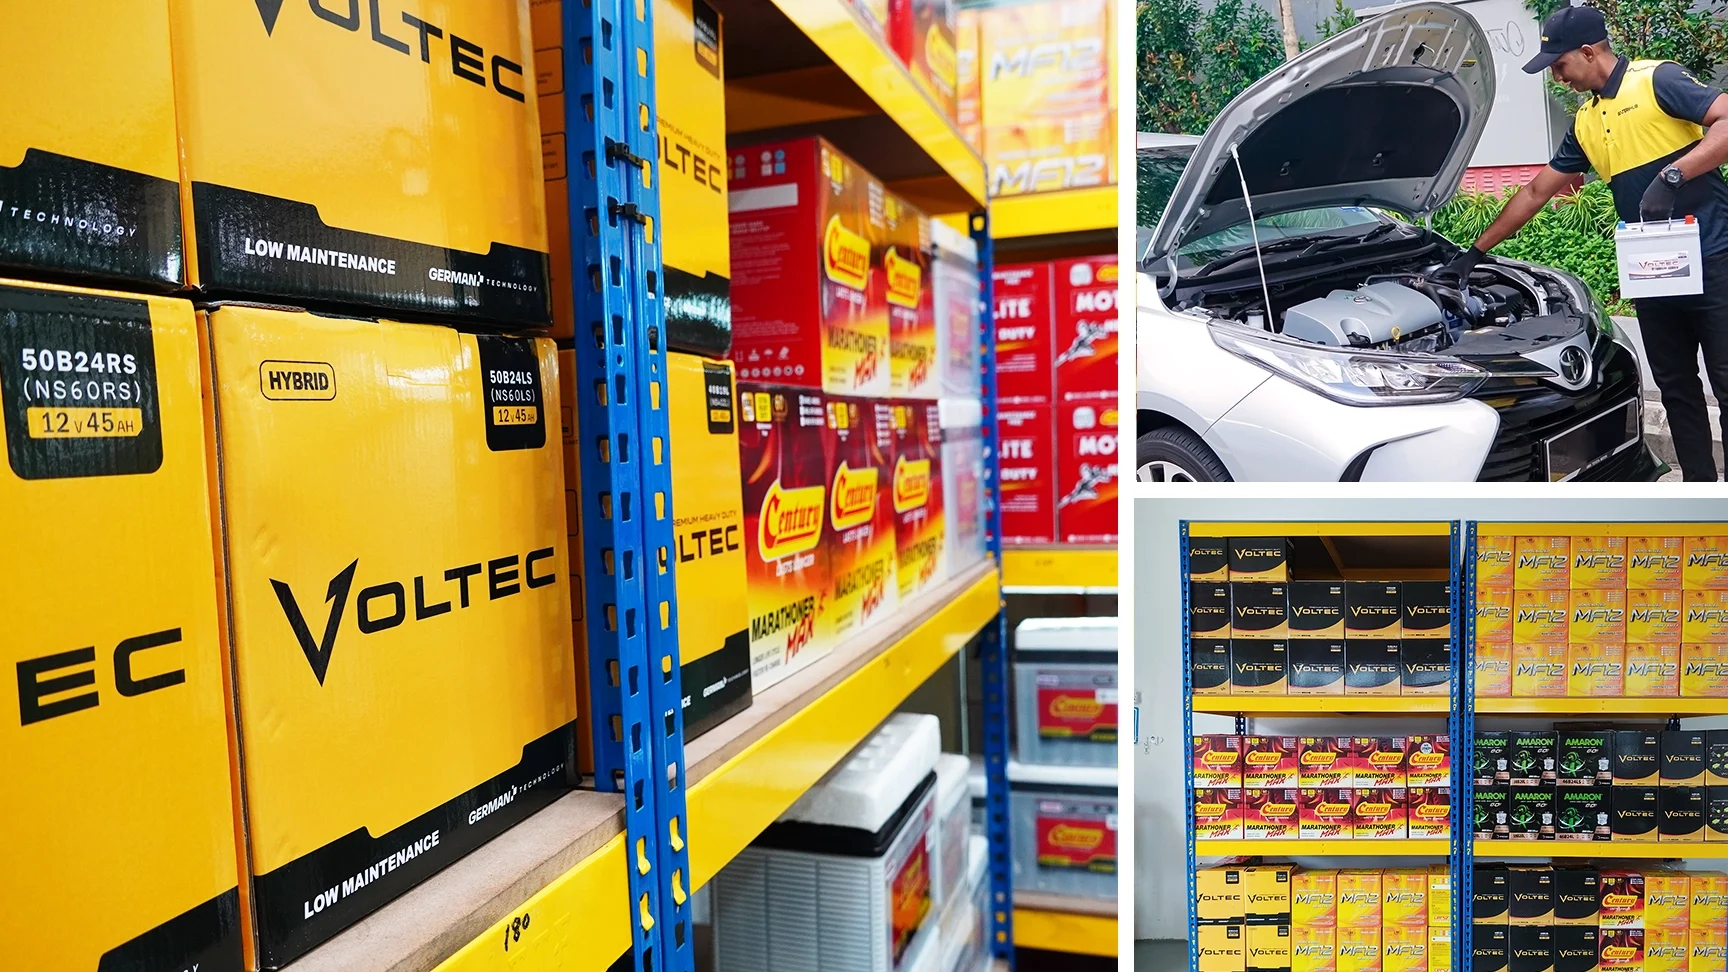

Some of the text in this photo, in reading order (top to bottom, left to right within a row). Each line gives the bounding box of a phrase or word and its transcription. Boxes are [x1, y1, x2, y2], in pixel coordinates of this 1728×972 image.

[255, 0, 525, 103] OLTEC
[657, 133, 721, 195] LTEC
[991, 154, 1105, 195] MF12
[10, 206, 136, 238] TECHNOLOGY
[245, 238, 396, 275] LOW MAINTENANCE
[428, 267, 538, 293] GERMAN TECHNOLOGY
[22, 348, 137, 375] 50B24RS
[268, 370, 330, 393] HYBRID
[489, 369, 533, 385] 50B24LS
[23, 377, 141, 403] (NS60RS)
[490, 387, 536, 403] (NS60LS)
[42, 411, 70, 433] 12
[86, 411, 114, 432] 45
[498, 408, 510, 423] 12
[515, 408, 527, 422] 45
[998, 438, 1034, 460] ITE
[1078, 434, 1118, 456] MO
[764, 493, 821, 549] Century
[674, 524, 739, 563] LTEC
[1235, 548, 1281, 560] VOLTEC
[1518, 555, 1569, 569] MF12
[1575, 554, 1625, 568] MF12
[1631, 555, 1681, 568] MF12
[269, 546, 557, 688] VOLTEC
[1236, 605, 1284, 617] VOLTEC
[1292, 605, 1340, 617] VOLTEC
[1350, 605, 1397, 617] VOLTEC
[1517, 609, 1568, 622] MF12
[1573, 609, 1624, 622] MF12
[1630, 609, 1680, 622] MF12
[751, 595, 815, 643] MARATHONER
[1236, 662, 1283, 674] VOLTEC
[1293, 664, 1340, 675] VOLTEC
[1349, 664, 1396, 675] VOLTEC
[1516, 662, 1566, 676] MF12
[1572, 662, 1622, 676] MF12
[1627, 662, 1678, 676] MF12
[1516, 738, 1554, 746] AMARON
[1565, 738, 1603, 746] AMARON
[1618, 755, 1655, 763] VOLTEC
[1666, 755, 1702, 763] VOLTEC
[467, 762, 565, 825] GERMAN TECHNOLOGY
[1617, 810, 1654, 818] VOLTEC
[1665, 811, 1700, 819] VOLTEC
[303, 830, 440, 919] LOW MAINTENANCE
[1248, 894, 1287, 903] VOLTEC
[1296, 893, 1334, 904] MF12
[1340, 893, 1379, 904] MF12
[1386, 892, 1425, 903] MF12
[1514, 893, 1550, 902] VOLTEC
[1559, 895, 1595, 903] VOLTEC
[1648, 895, 1688, 906] MF12
[504, 912, 531, 953] 180
[1249, 948, 1288, 957] VOLTEC
[1295, 945, 1334, 956] MF12
[1340, 945, 1379, 956] MF12
[1386, 944, 1425, 955] MF12
[1514, 949, 1550, 958] VOLTEC
[1559, 949, 1594, 958] VOLTEC
[1648, 947, 1687, 958] MF12
